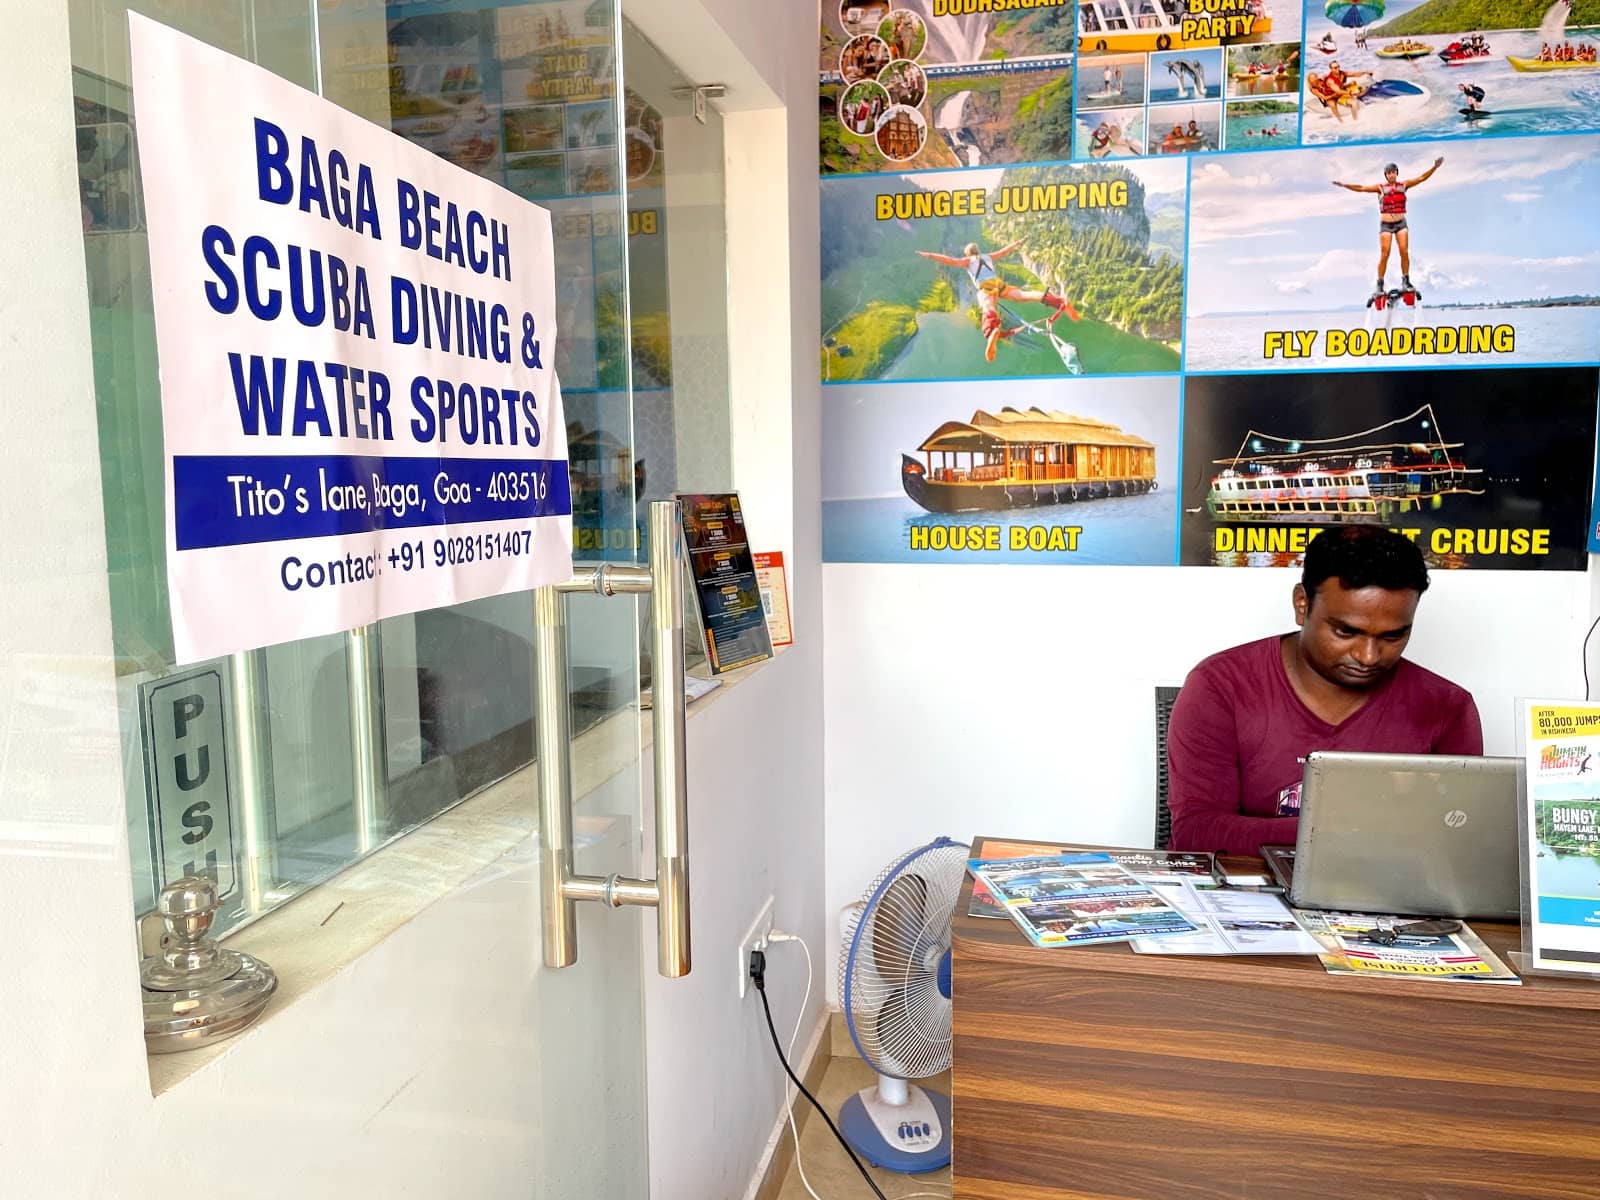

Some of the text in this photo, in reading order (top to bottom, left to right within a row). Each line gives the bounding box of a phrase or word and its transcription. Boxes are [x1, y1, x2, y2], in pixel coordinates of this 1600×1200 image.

[933, 0, 1066, 16] DUDHS
[1182, 14, 1257, 41] PARTY
[254, 117, 511, 282] BAGA BEACH
[876, 180, 1129, 220] BUNGEE JUMPING
[201, 225, 543, 370] SCUBA DIVING &
[1263, 324, 1515, 359] FLY BOADRDING
[228, 352, 541, 448] WATER SPORTS
[227, 473, 310, 517] Tito's
[319, 468, 372, 516] lane,
[372, 473, 427, 518] Baga,
[434, 472, 472, 505] Goa
[487, 471, 547, 502] 403516
[388, 541, 425, 572] +91
[434, 530, 532, 567] 9028151407
[910, 526, 1083, 552] HOUSE BOAT
[1431, 528, 1550, 555] CRUISE
[1552, 807, 1598, 825] BUNGY
[1554, 824, 1577, 832] MAYEM
